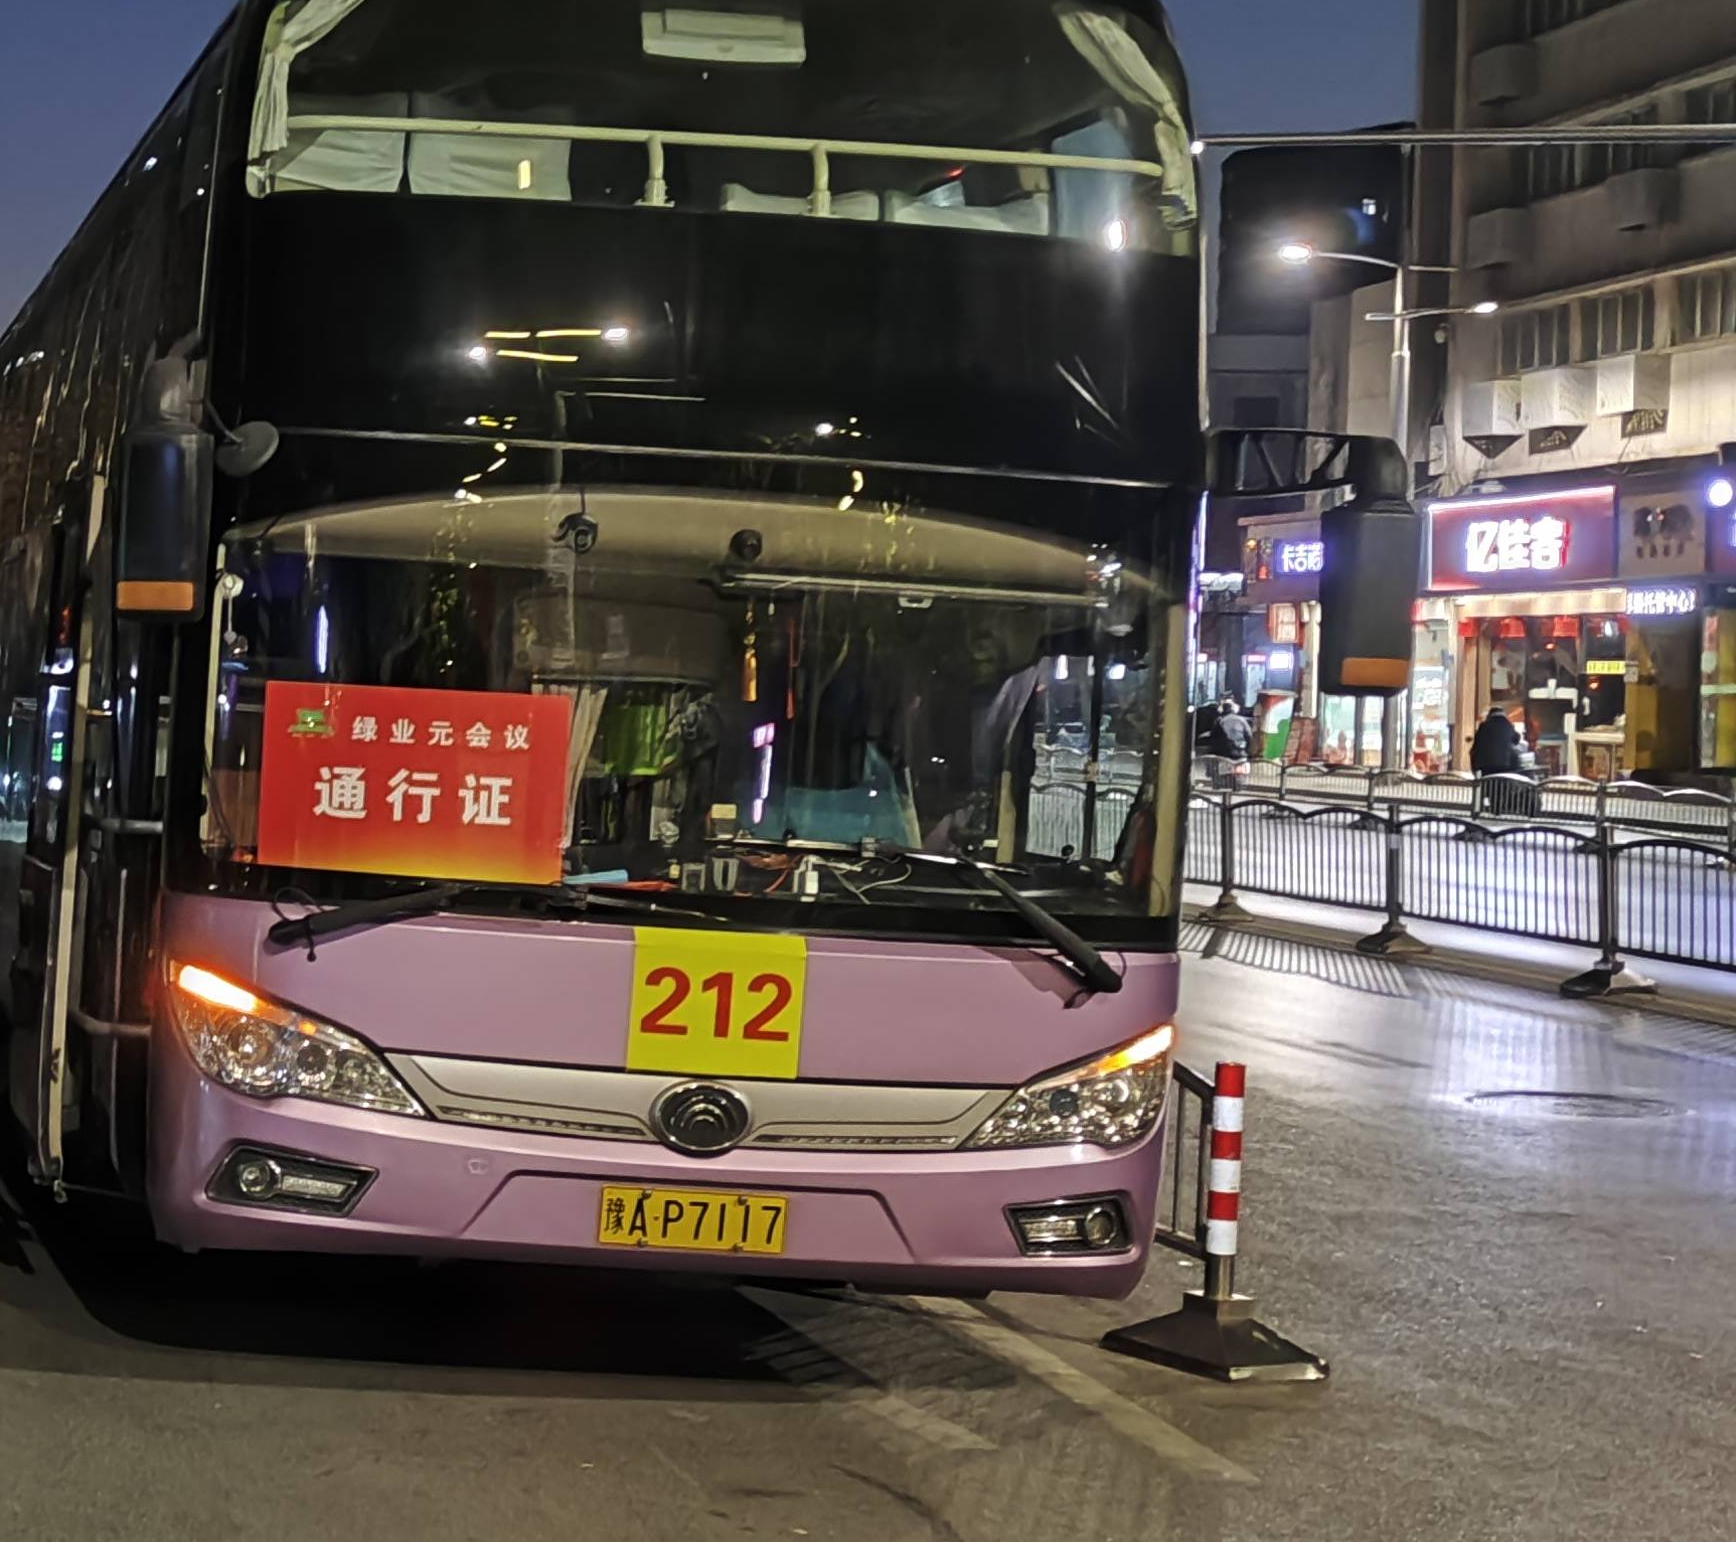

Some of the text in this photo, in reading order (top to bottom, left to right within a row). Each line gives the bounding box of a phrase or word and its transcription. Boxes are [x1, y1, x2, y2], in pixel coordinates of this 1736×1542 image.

[351, 716, 531, 751] 绿业元会议
[313, 767, 514, 827] 通行证
[640, 966, 794, 1043] 212
